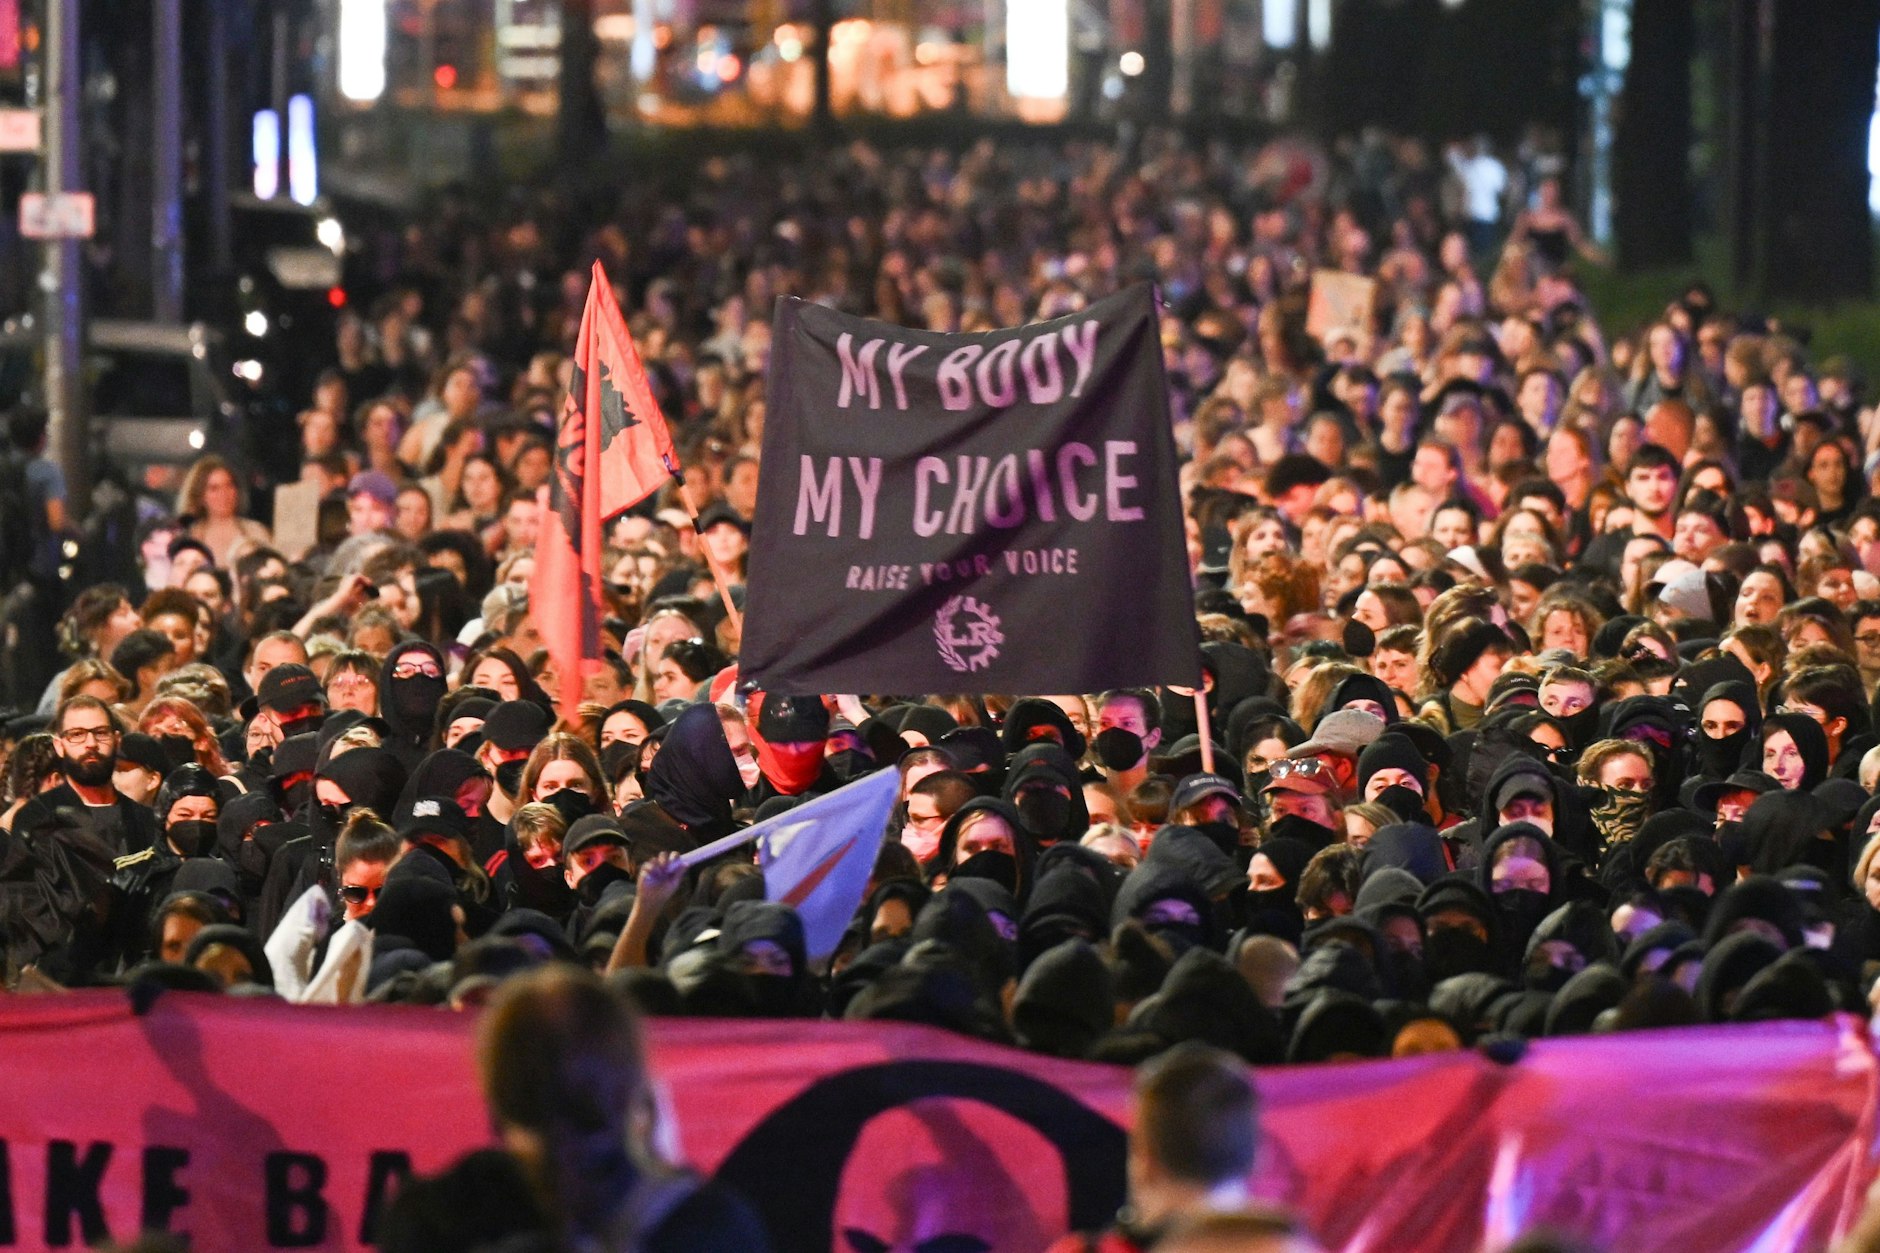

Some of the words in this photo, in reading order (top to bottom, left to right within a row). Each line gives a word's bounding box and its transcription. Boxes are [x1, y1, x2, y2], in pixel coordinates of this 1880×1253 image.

[837, 332, 929, 410] MY
[937, 319, 1099, 411] BODY
[793, 454, 882, 540] MY
[913, 440, 1145, 538] CHOICE
[845, 564, 912, 591] RAISE
[919, 553, 993, 586] YOUR
[1003, 547, 1079, 576] VOICE
